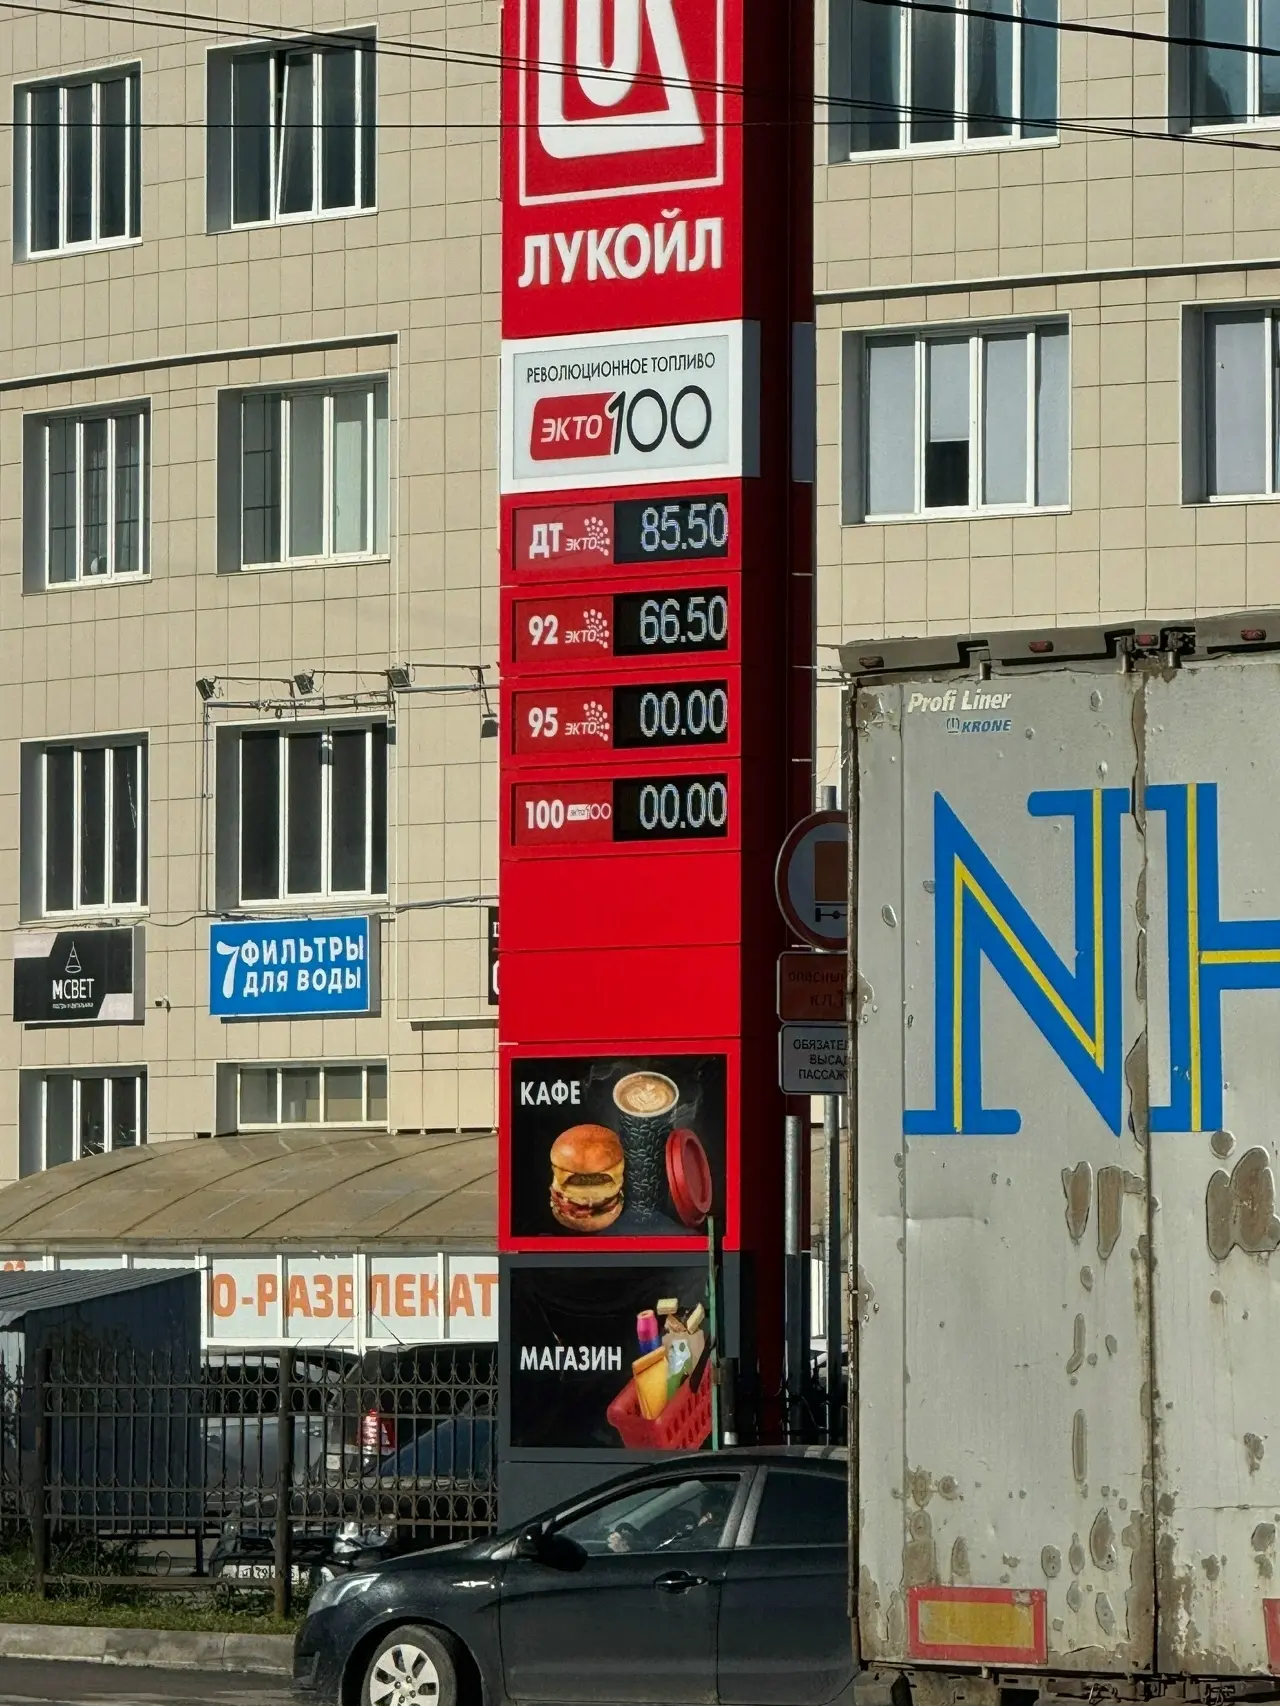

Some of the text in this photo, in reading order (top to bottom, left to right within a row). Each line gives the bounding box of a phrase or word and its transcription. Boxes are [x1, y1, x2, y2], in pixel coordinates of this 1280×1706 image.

[518, 207, 723, 288] ЛУКОЙЛ
[527, 352, 716, 383] РЕВОЛЮЦИОННОЕ ТОПЛИВО
[541, 415, 603, 443] ЭКТО
[529, 503, 728, 559] ДТ ЭКТО 85.50
[528, 596, 727, 645] 92 ЭКТО 66.50
[528, 689, 727, 737] 95 ЭКТО 00.00
[907, 689, 1012, 713] Profi Liner
[961, 719, 1012, 733] KRONE
[525, 799, 564, 830] 100
[640, 782, 727, 830] 00.00
[216, 935, 364, 999] 7 ФИЛЬТРЫ
[243, 966, 361, 997] ДЛЯ ВОДЫ
[520, 1079, 581, 1105] КАФЕ
[520, 1345, 622, 1371] МАГАЗИН
